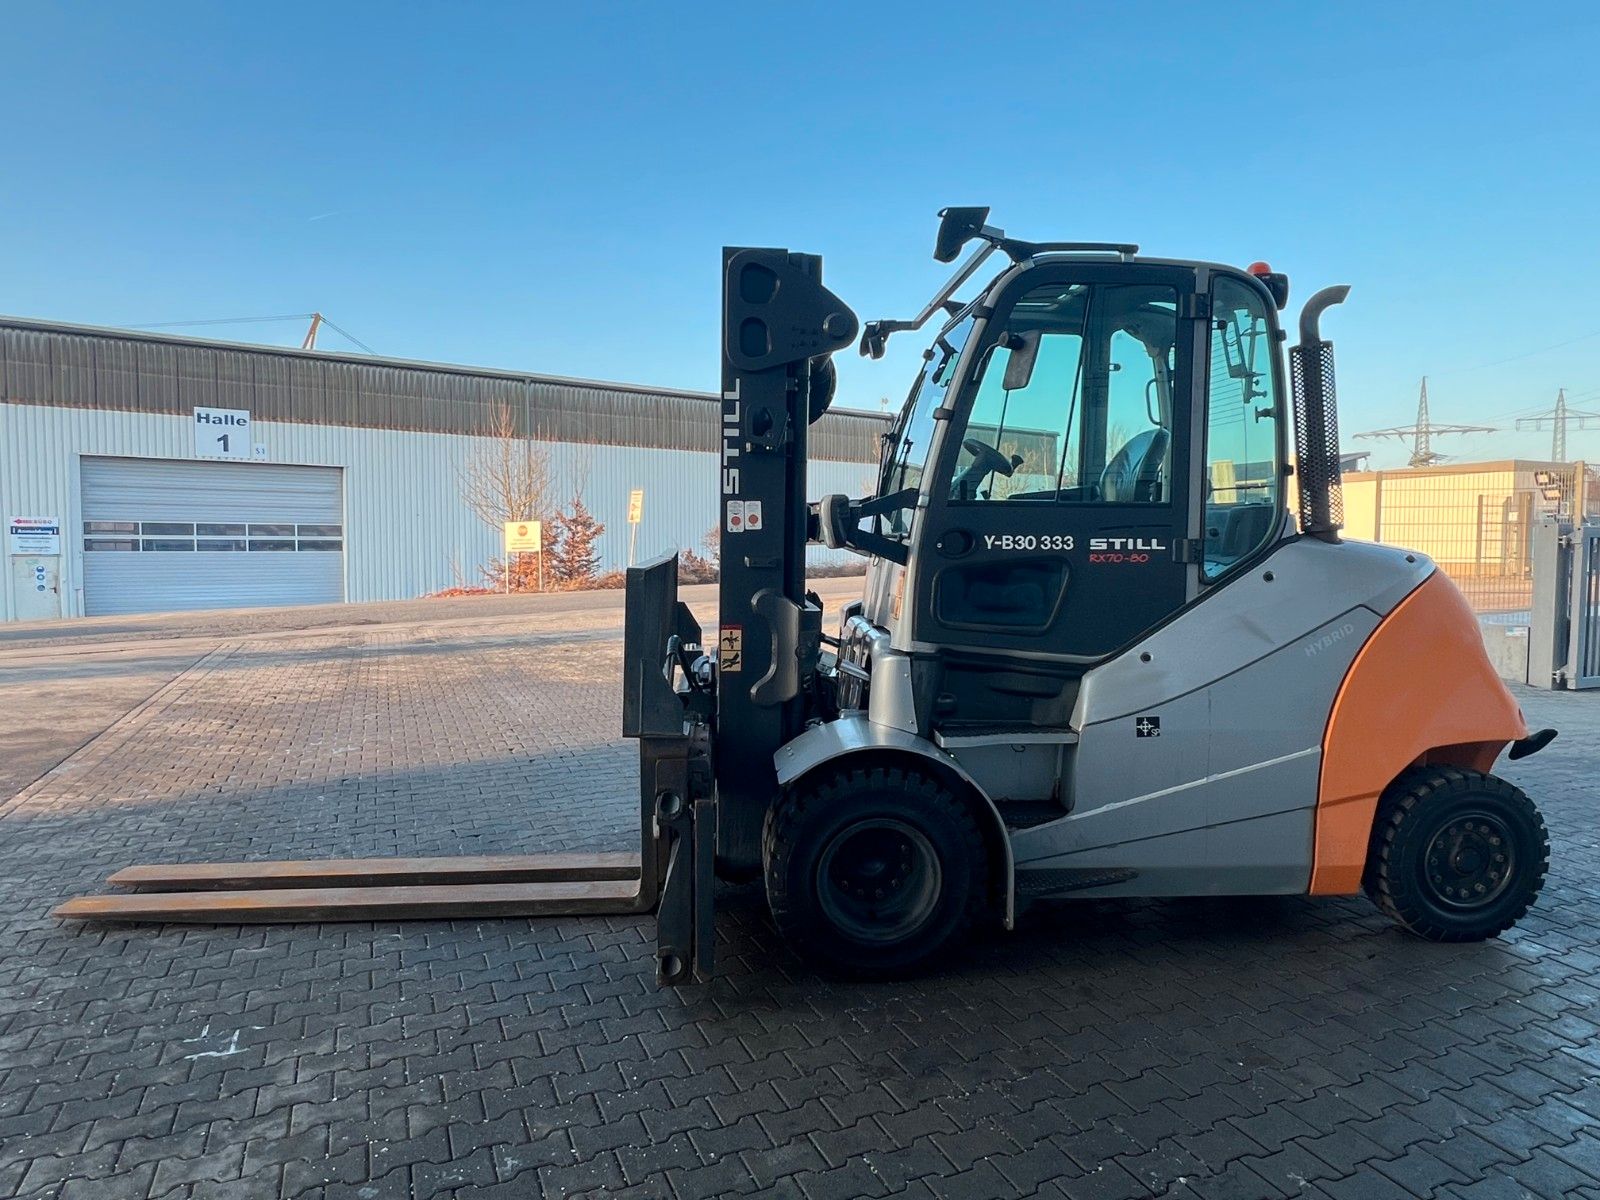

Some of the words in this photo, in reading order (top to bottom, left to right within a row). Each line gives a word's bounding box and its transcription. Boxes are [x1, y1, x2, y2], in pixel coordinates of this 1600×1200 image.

[196, 413, 248, 426] Halle
[217, 434, 229, 452] 1
[723, 378, 740, 494] STILL
[984, 535, 1037, 550] Y-B30
[1040, 535, 1074, 550] 333
[1090, 538, 1166, 550] STILL
[1089, 553, 1149, 563] RX70-80
[1304, 623, 1354, 657] HYBRID
